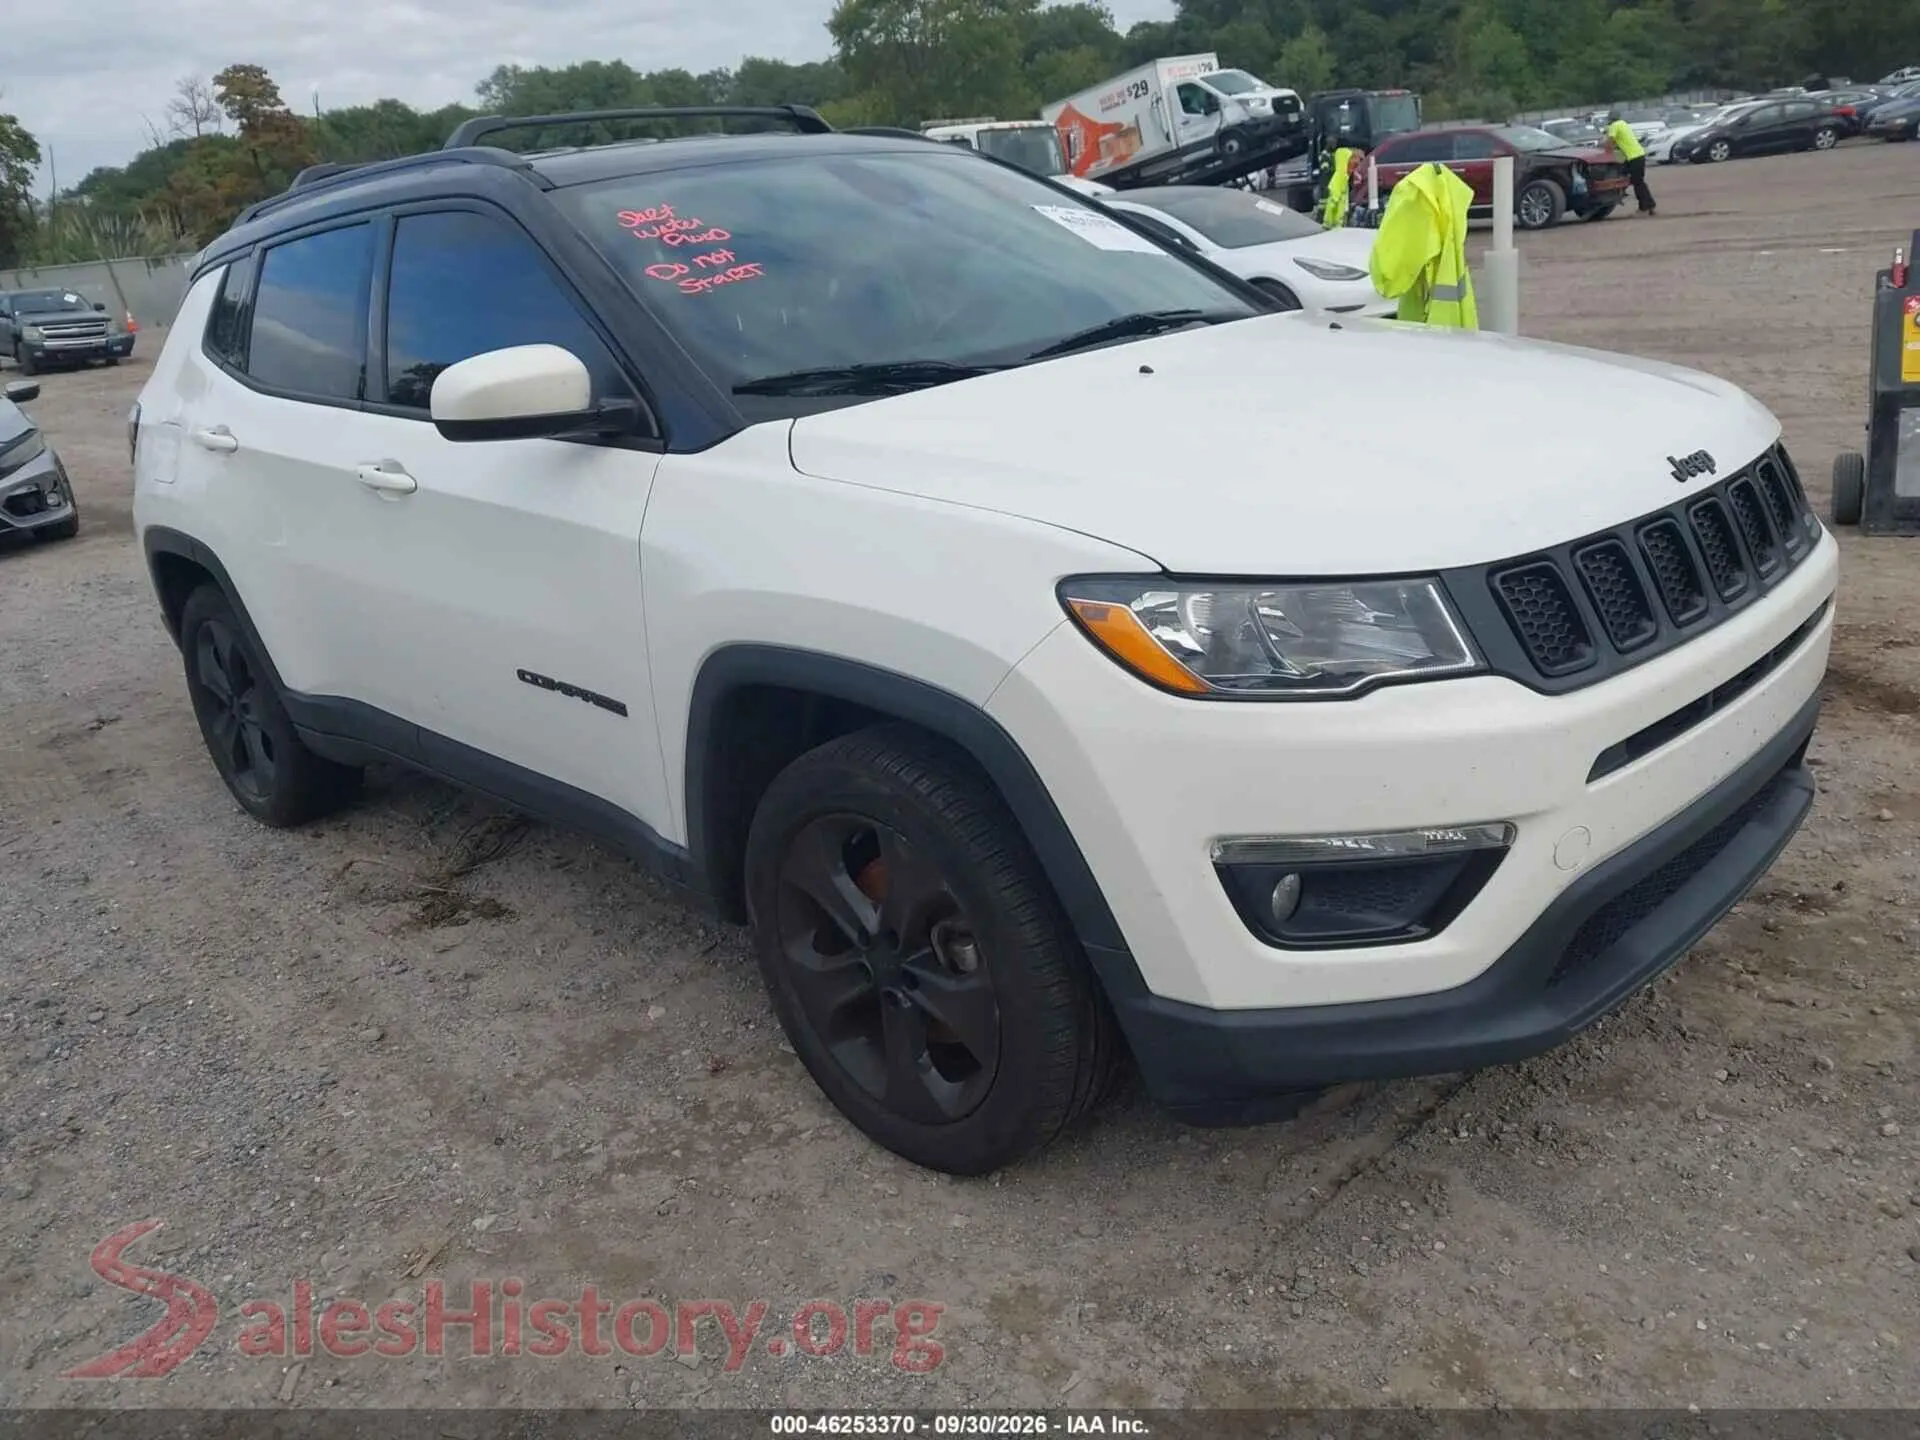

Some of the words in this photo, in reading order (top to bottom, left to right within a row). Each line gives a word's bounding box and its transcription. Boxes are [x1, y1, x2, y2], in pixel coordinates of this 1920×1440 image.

[1126, 80, 1149, 99] $29
[692, 249, 736, 268] not
[1666, 449, 1717, 483] Jeep
